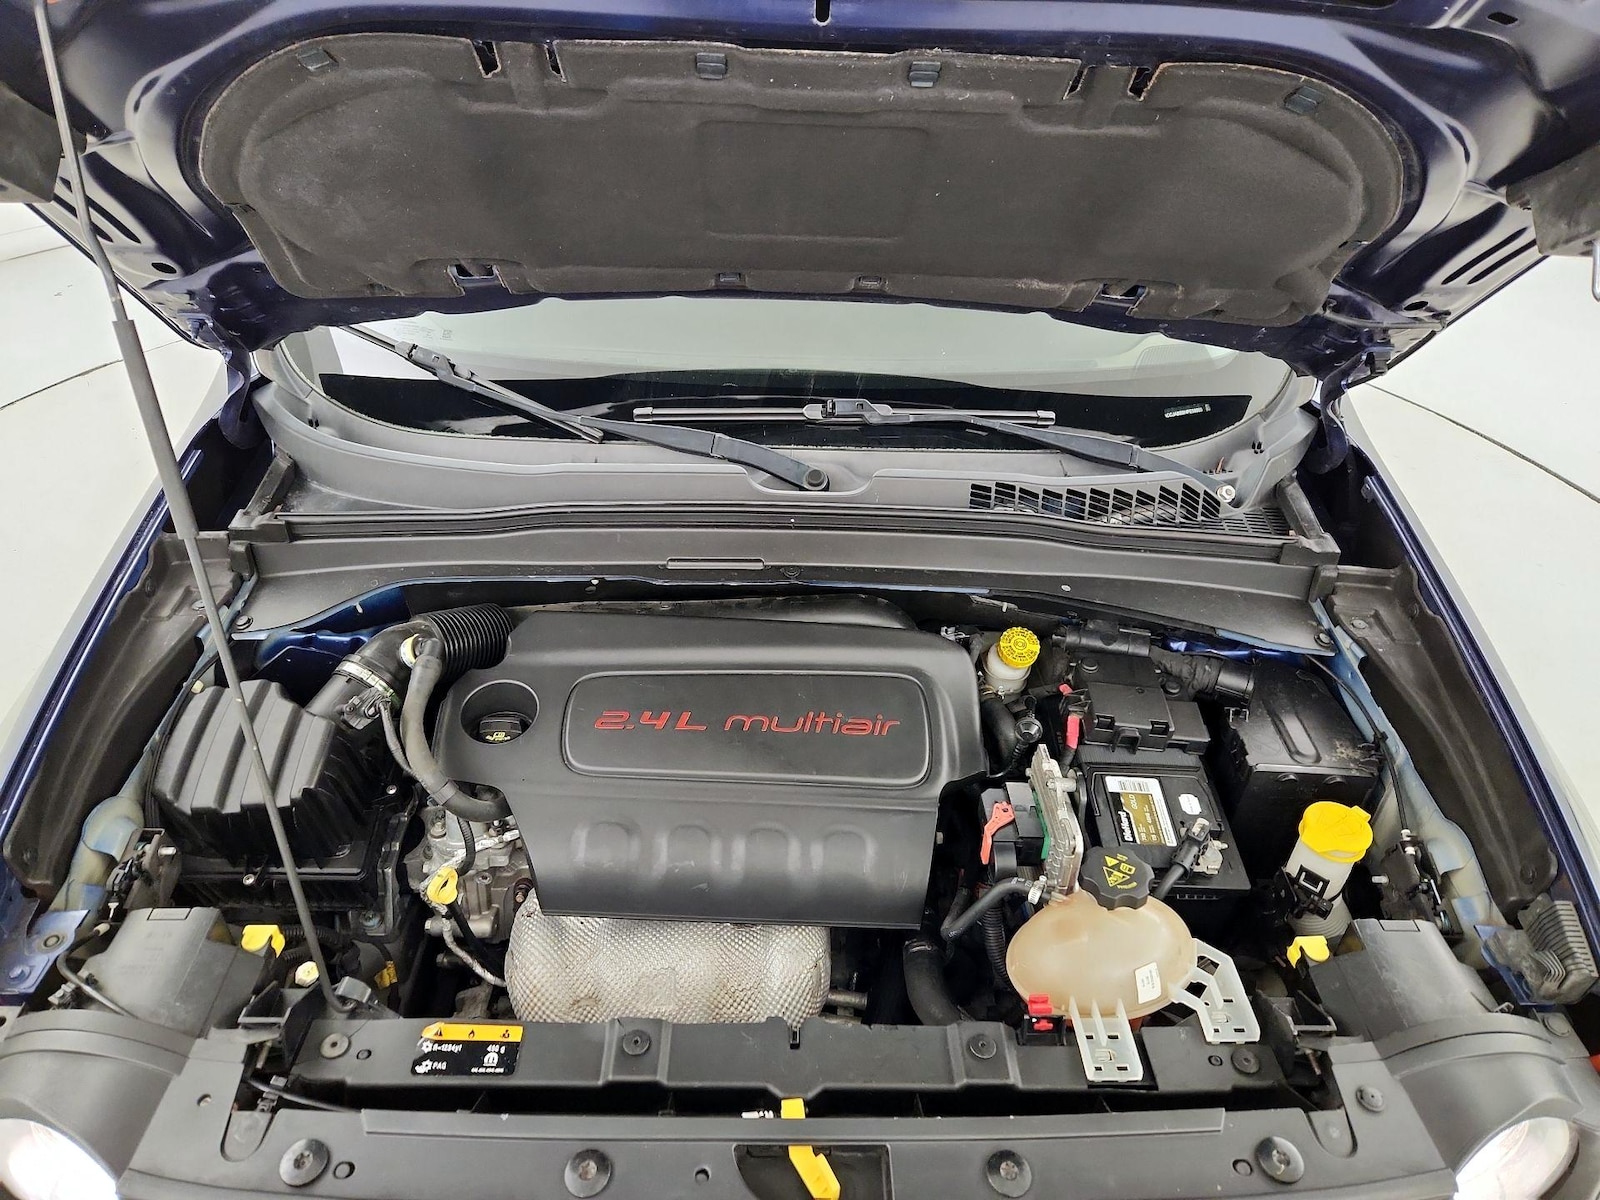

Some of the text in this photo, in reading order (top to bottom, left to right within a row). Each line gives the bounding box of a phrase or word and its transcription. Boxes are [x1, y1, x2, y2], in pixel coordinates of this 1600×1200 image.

[724, 711, 900, 736] multiair
[1129, 793, 1138, 810] GOLD
[1118, 811, 1133, 841] DieHard
